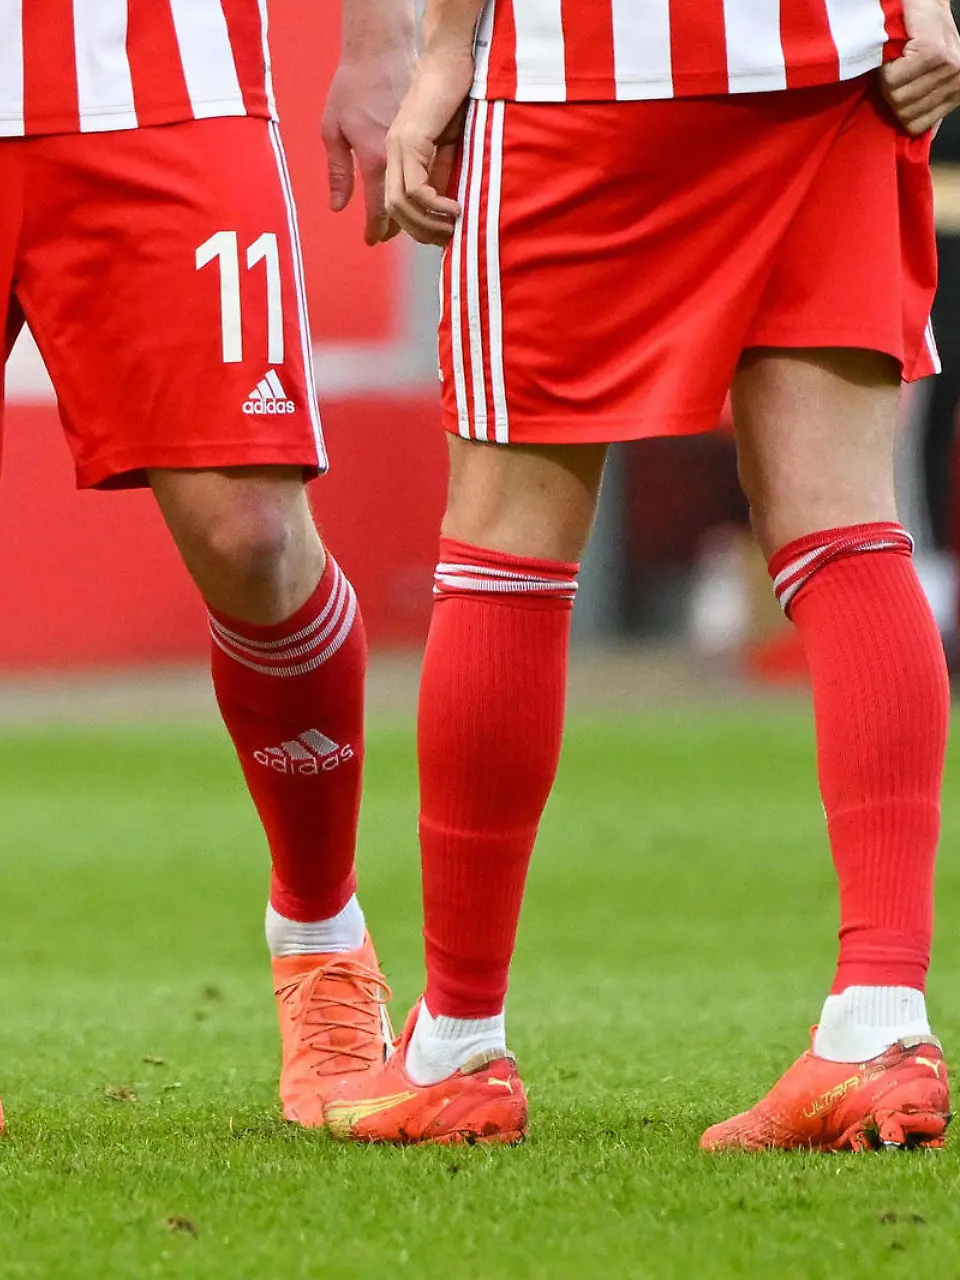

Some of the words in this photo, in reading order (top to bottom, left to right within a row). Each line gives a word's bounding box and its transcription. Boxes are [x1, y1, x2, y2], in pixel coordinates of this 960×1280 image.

[195, 230, 285, 365] 11
[242, 398, 296, 415] adidas
[253, 743, 354, 775] adidas
